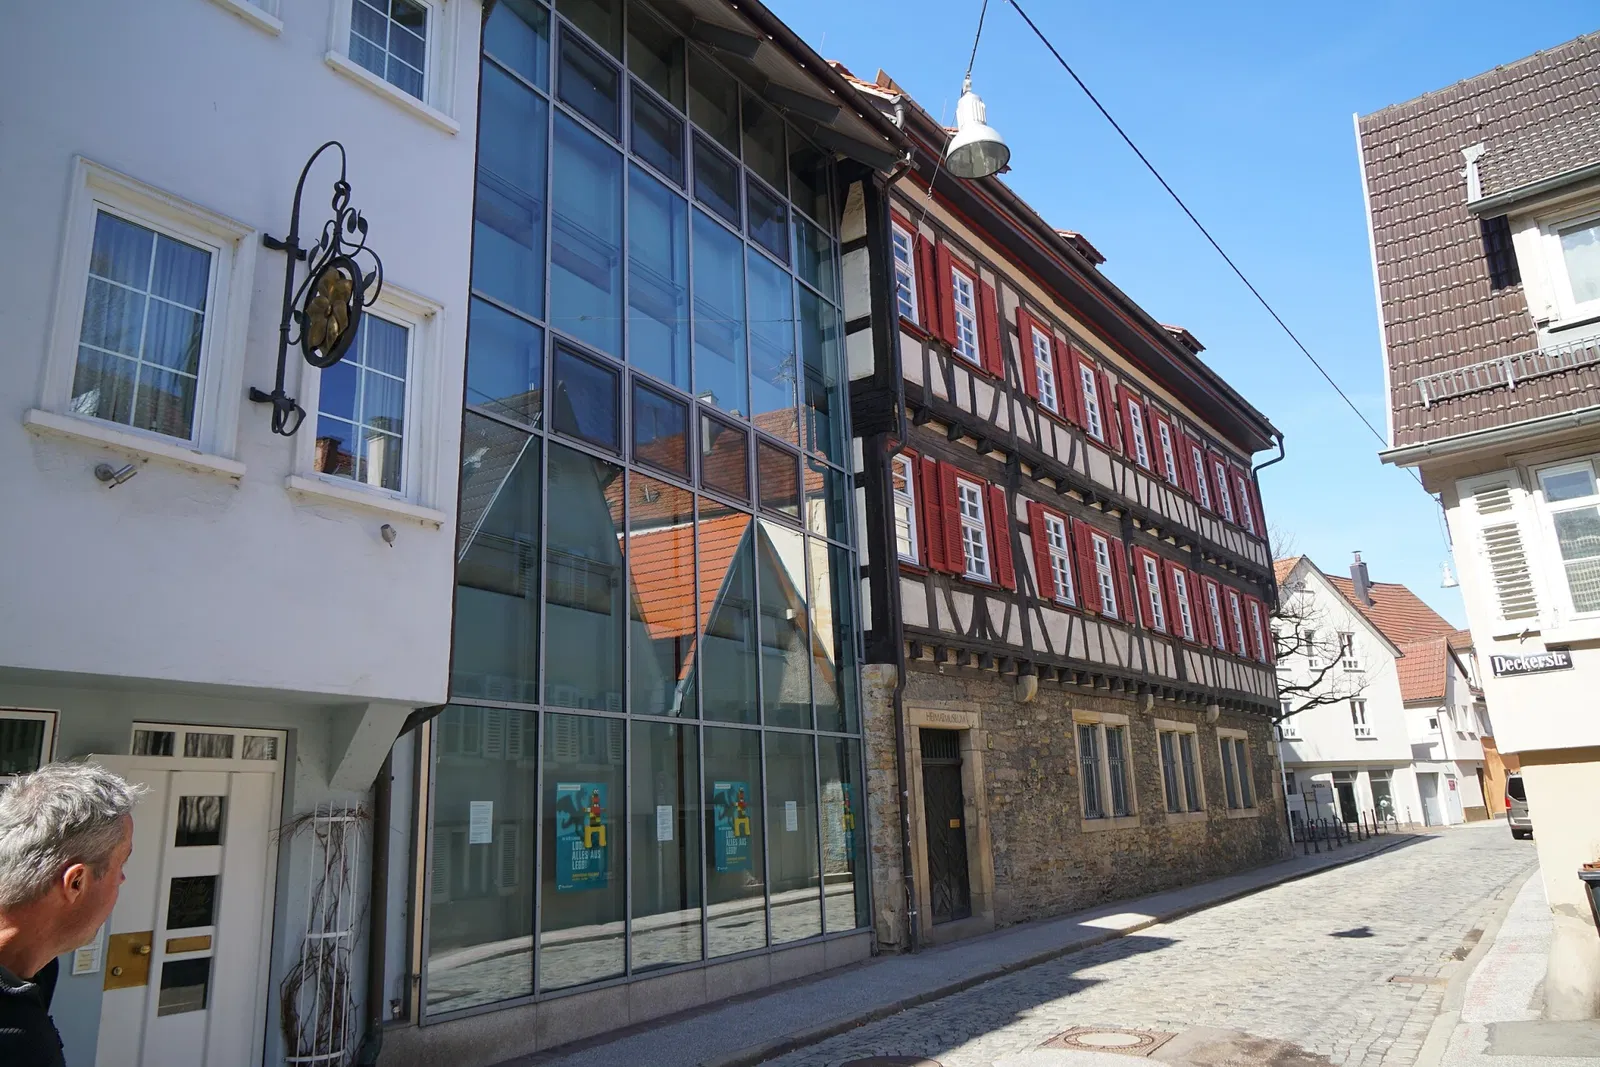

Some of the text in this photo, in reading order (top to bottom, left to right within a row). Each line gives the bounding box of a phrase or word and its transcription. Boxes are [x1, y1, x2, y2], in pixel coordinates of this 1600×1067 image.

[1493, 652, 1568, 673] Deckerstr.
[572, 849, 601, 860] ALLES AUS
